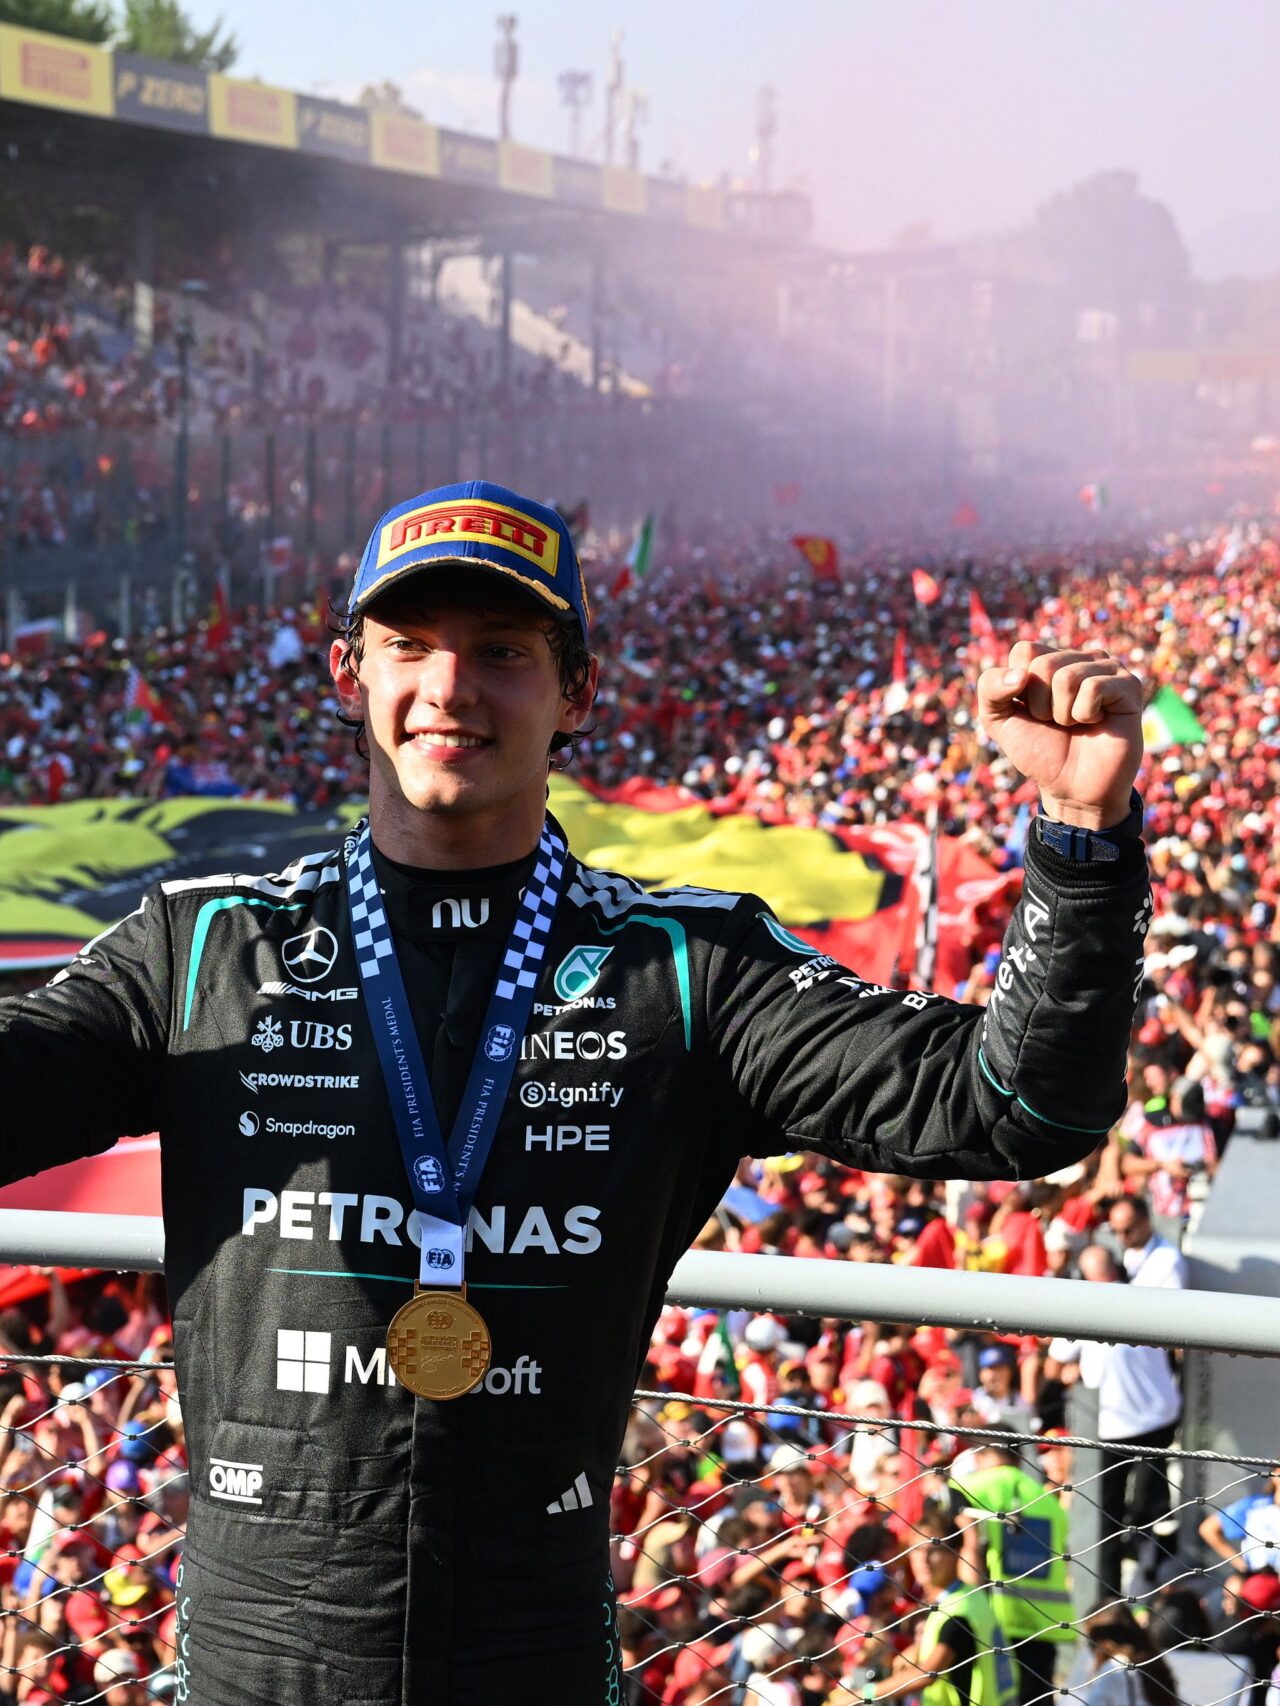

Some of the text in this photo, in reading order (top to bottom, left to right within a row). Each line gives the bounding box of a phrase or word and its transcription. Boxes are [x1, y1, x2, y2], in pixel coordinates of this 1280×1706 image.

[389, 505, 549, 558] PIRELLI
[788, 955, 841, 986] PETRO
[284, 984, 359, 1002] AMG
[533, 996, 617, 1017] PETRONAS
[289, 1020, 353, 1051] UBS
[519, 1030, 628, 1060] INEOS
[246, 1072, 360, 1089] CROWDSTRIKE
[381, 996, 424, 1138] FIA PRESIDENT'S MEDAL
[480, 1078, 495, 1098] FIA
[265, 1117, 355, 1139] Snapdragon
[454, 1100, 488, 1178] PRESIDENT'S
[525, 1124, 610, 1152] HPE
[241, 1187, 603, 1255] PETRNAS
[209, 1465, 263, 1497] OMP
